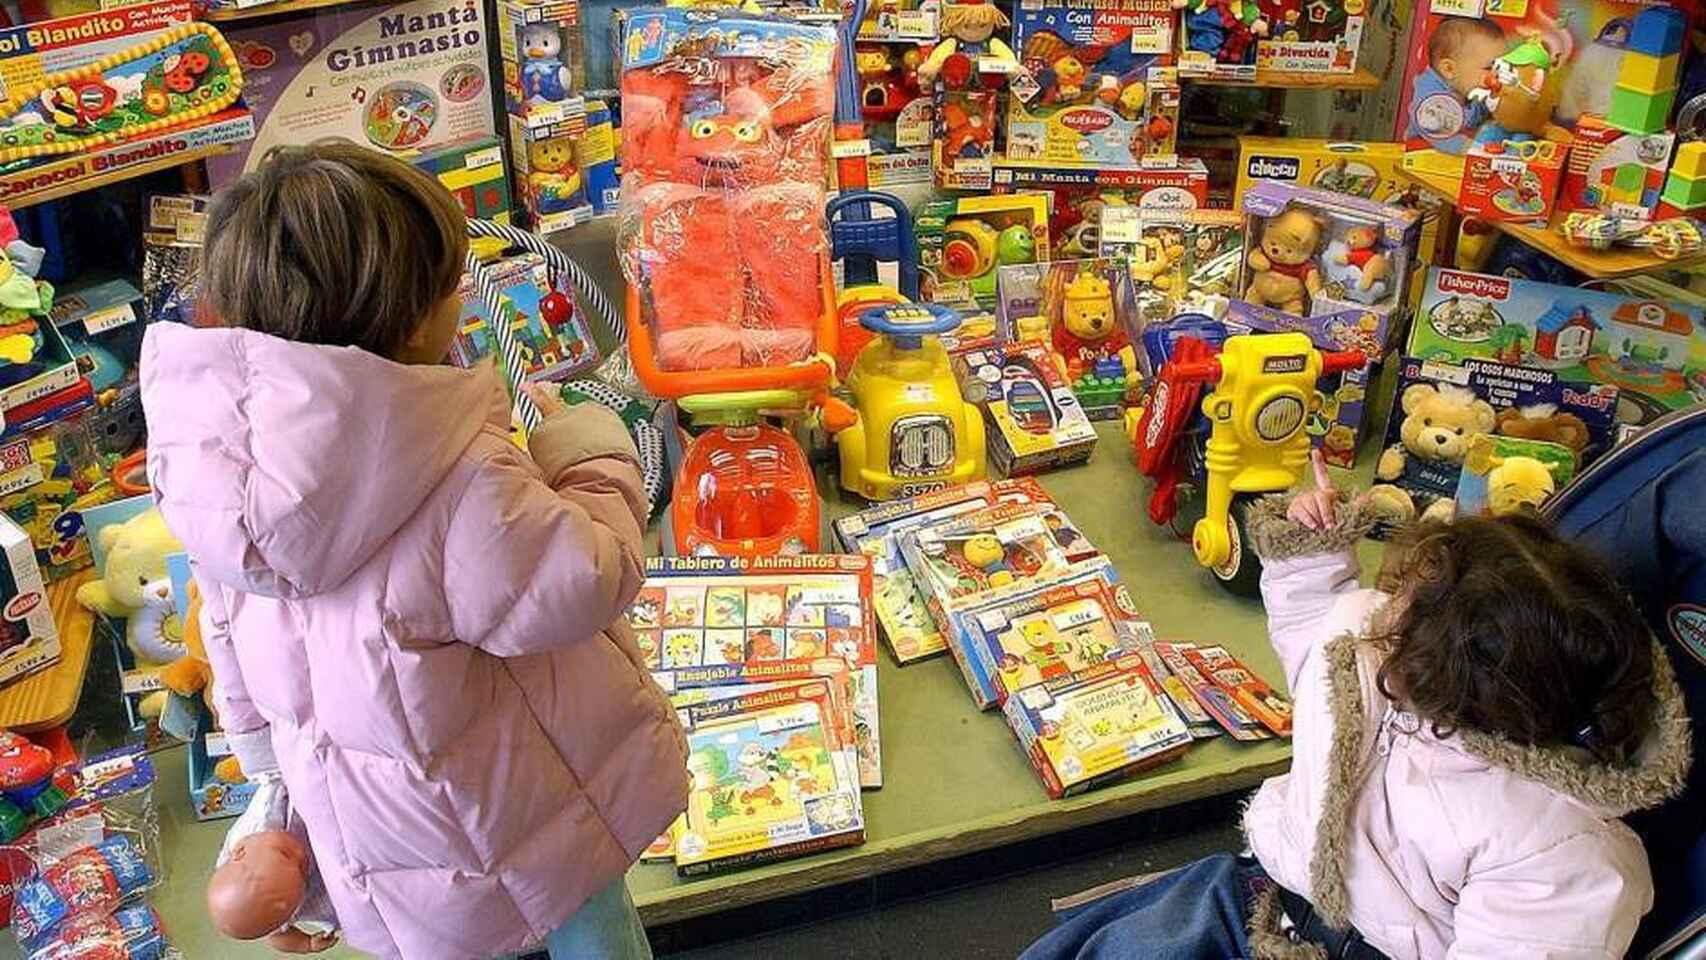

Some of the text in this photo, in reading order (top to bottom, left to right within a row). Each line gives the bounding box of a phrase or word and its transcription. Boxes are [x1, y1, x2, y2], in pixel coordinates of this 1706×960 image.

[378, 6, 479, 39] Manta
[1066, 12, 1170, 26] Con Animalitos
[26, 16, 125, 47] Blandito
[326, 28, 480, 72] Gimnasio
[1280, 47, 1330, 59] Divertida
[0, 138, 188, 197] Caracol Blandito
[1250, 159, 1297, 177] chicco
[1015, 173, 1036, 181] Mi
[1041, 174, 1090, 183] Manta
[1094, 176, 1120, 185] con
[1441, 273, 1507, 294] Fisher-Price
[1268, 359, 1302, 369] MOLTO
[1464, 360, 1553, 384] LOS OSOS MARCHOSOS
[646, 557, 664, 570] Mi
[669, 556, 726, 570] Tablero
[729, 556, 749, 570] de
[752, 555, 836, 570] Animalitos
[740, 663, 810, 677] Animalitos
[732, 691, 797, 711] Animalitos
